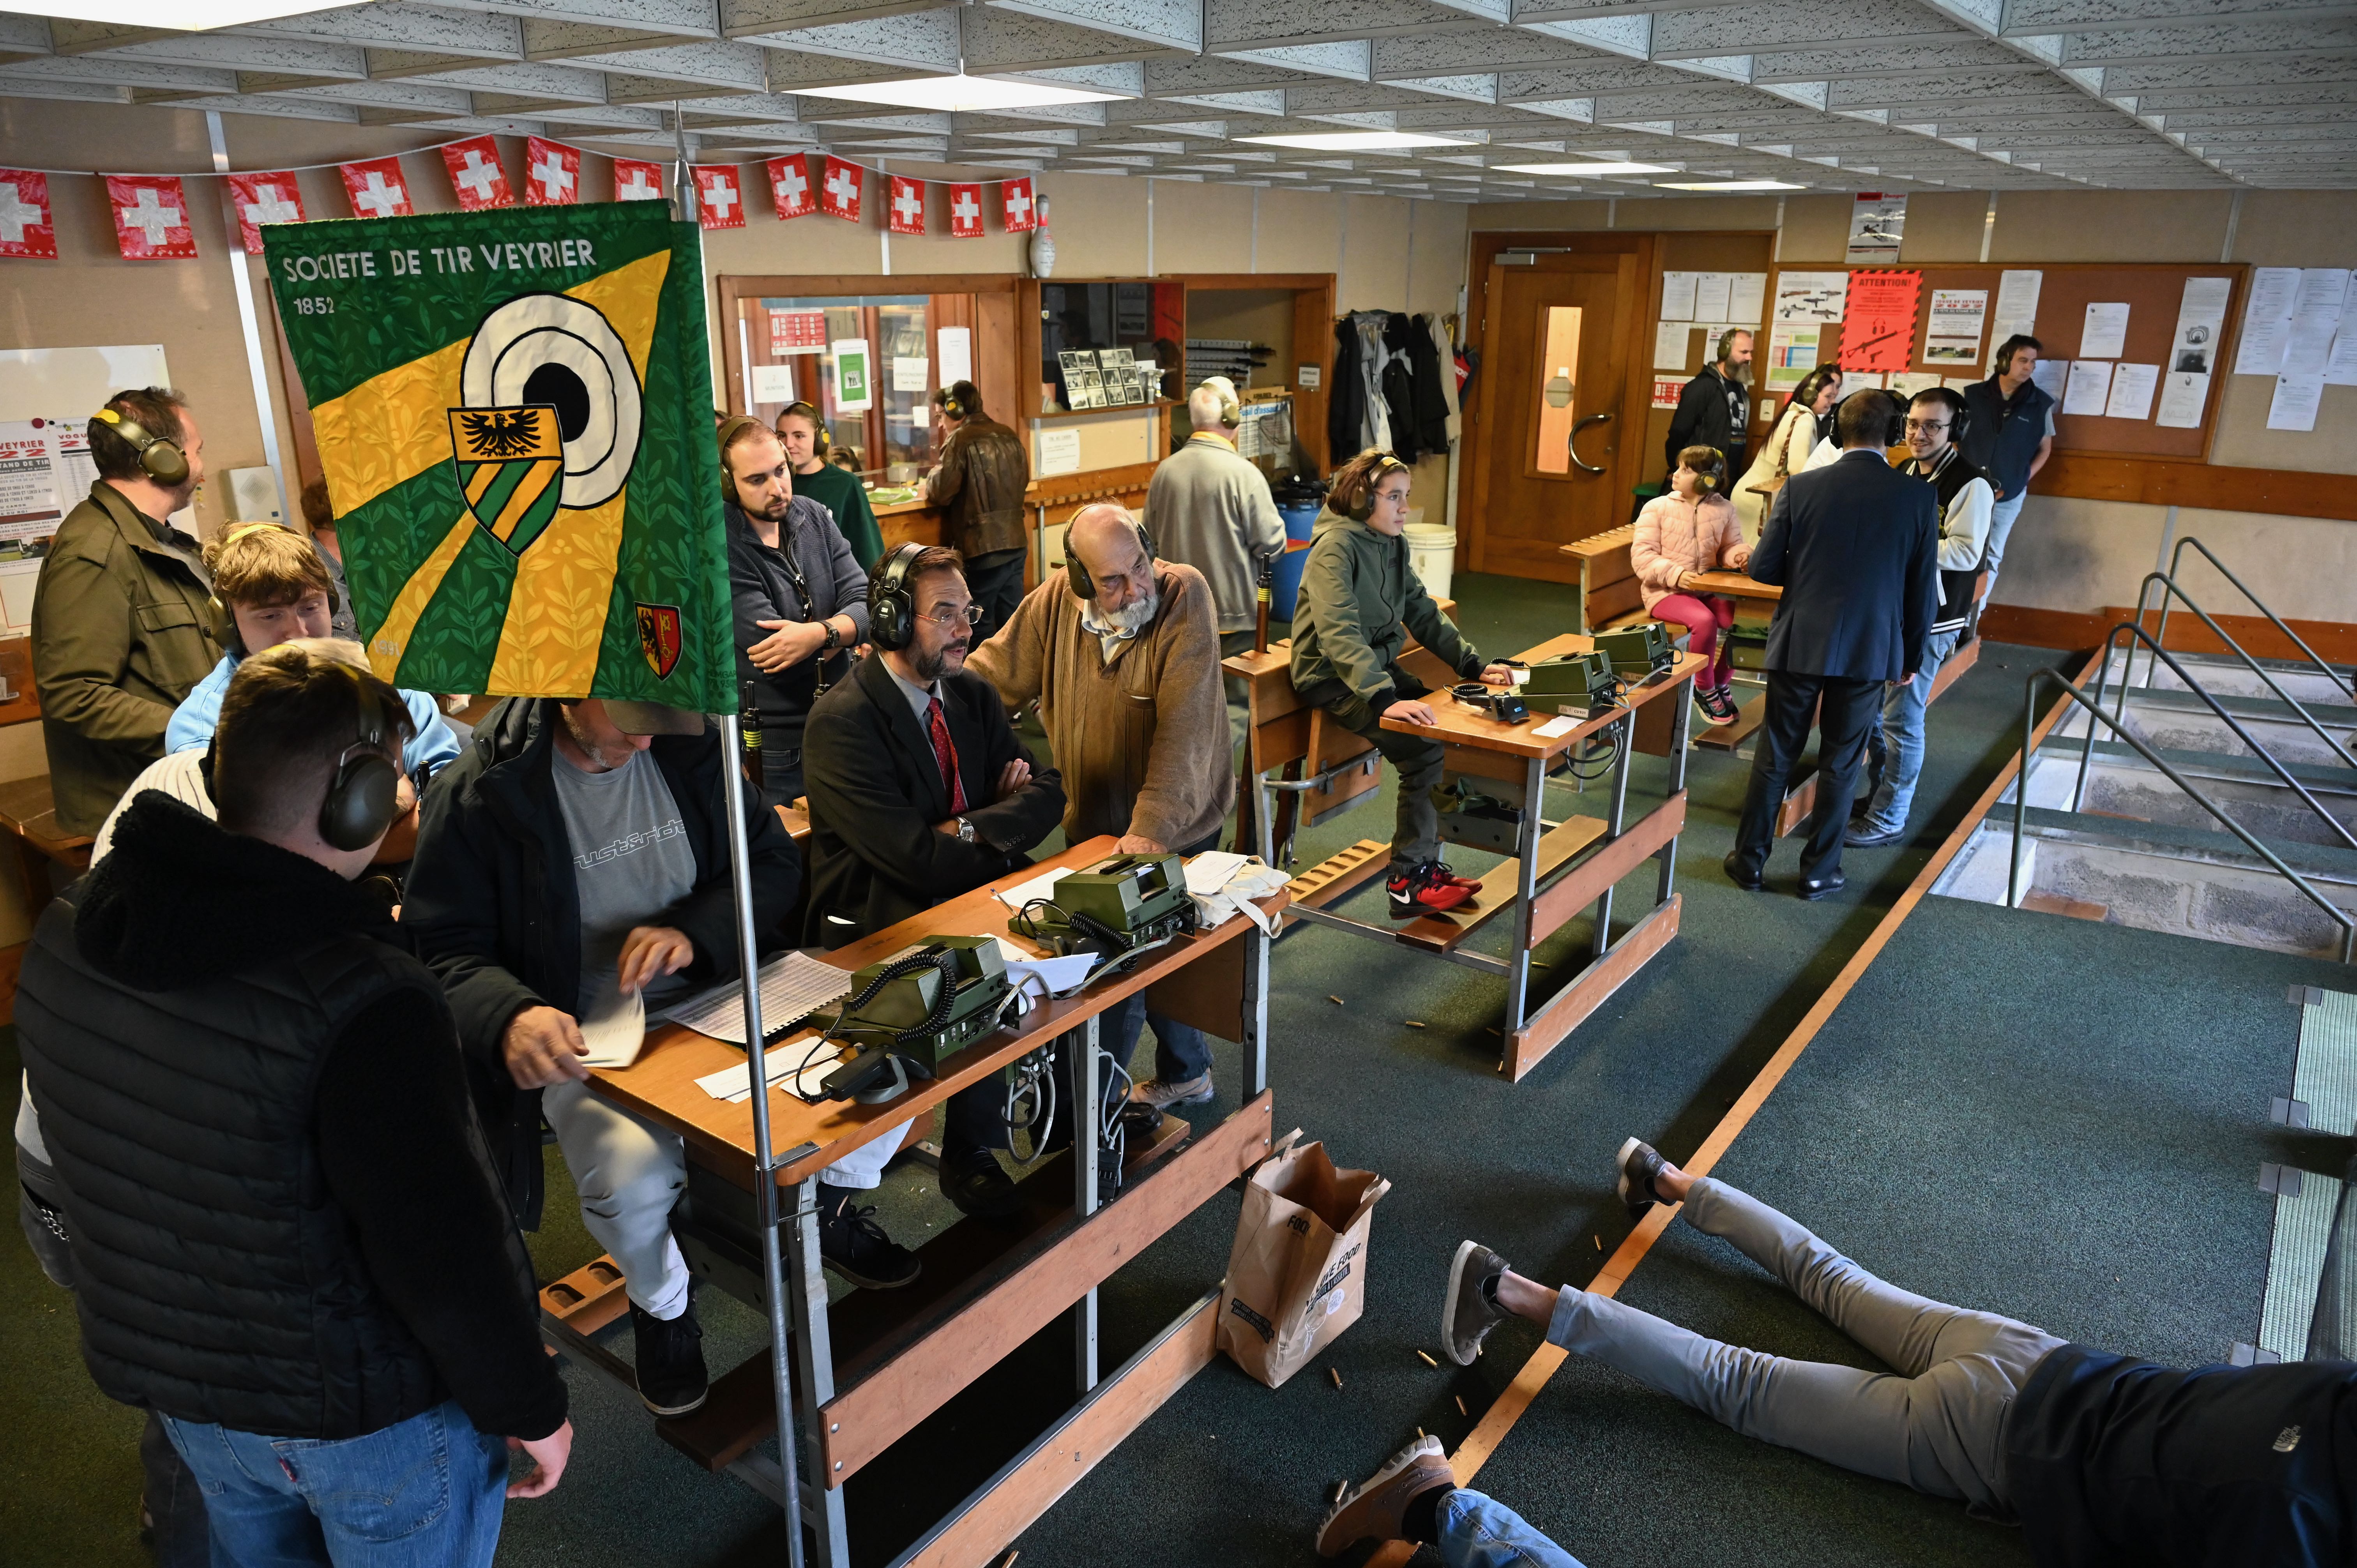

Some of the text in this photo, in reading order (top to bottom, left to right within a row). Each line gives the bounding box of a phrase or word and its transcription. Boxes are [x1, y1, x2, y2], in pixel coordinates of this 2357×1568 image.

[283, 239, 597, 283] SOCIETE DE TIR VEYRIER
[1859, 278, 1911, 286] ATTENTION!
[293, 297, 334, 315] 1852
[1240, 408, 1253, 416] usil
[1337, 1243, 1361, 1270] FOOD
